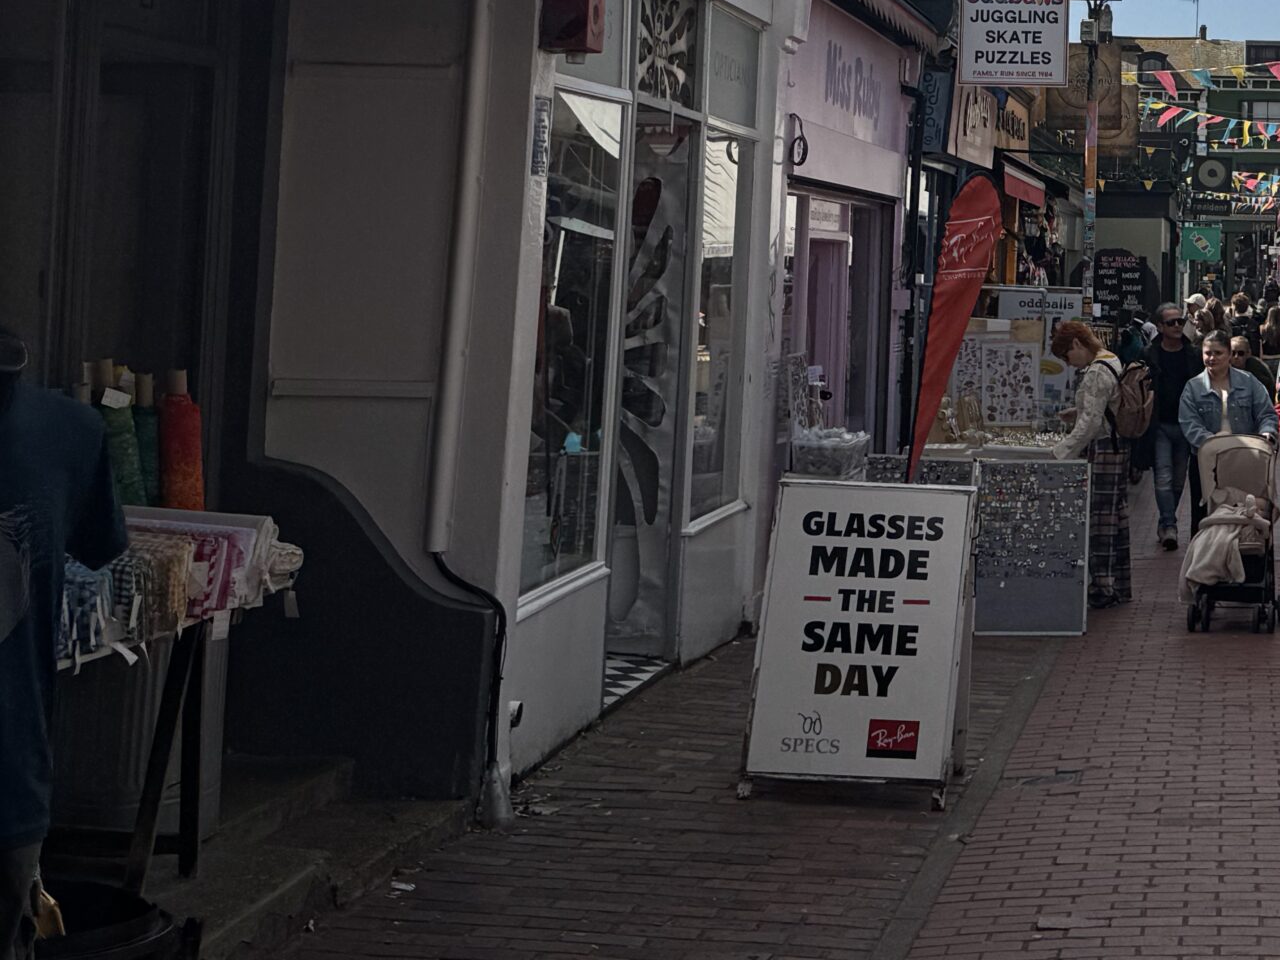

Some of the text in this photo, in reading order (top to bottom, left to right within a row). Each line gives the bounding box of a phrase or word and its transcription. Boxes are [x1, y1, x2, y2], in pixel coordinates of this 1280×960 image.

[970, 10, 1059, 24] JUGGLING
[985, 30, 1043, 44] SKATE
[974, 50, 1052, 65] PUZZLES
[825, 39, 852, 113] Miss
[853, 56, 881, 131] Ruby
[1192, 203, 1228, 212] resident
[802, 511, 944, 541] GLASSES
[808, 545, 930, 580] MADE
[838, 588, 896, 613] THE
[801, 620, 919, 656] SAME
[813, 662, 900, 697] DAY
[780, 736, 841, 754] SPECS
[870, 724, 915, 748] Ray-Ban
